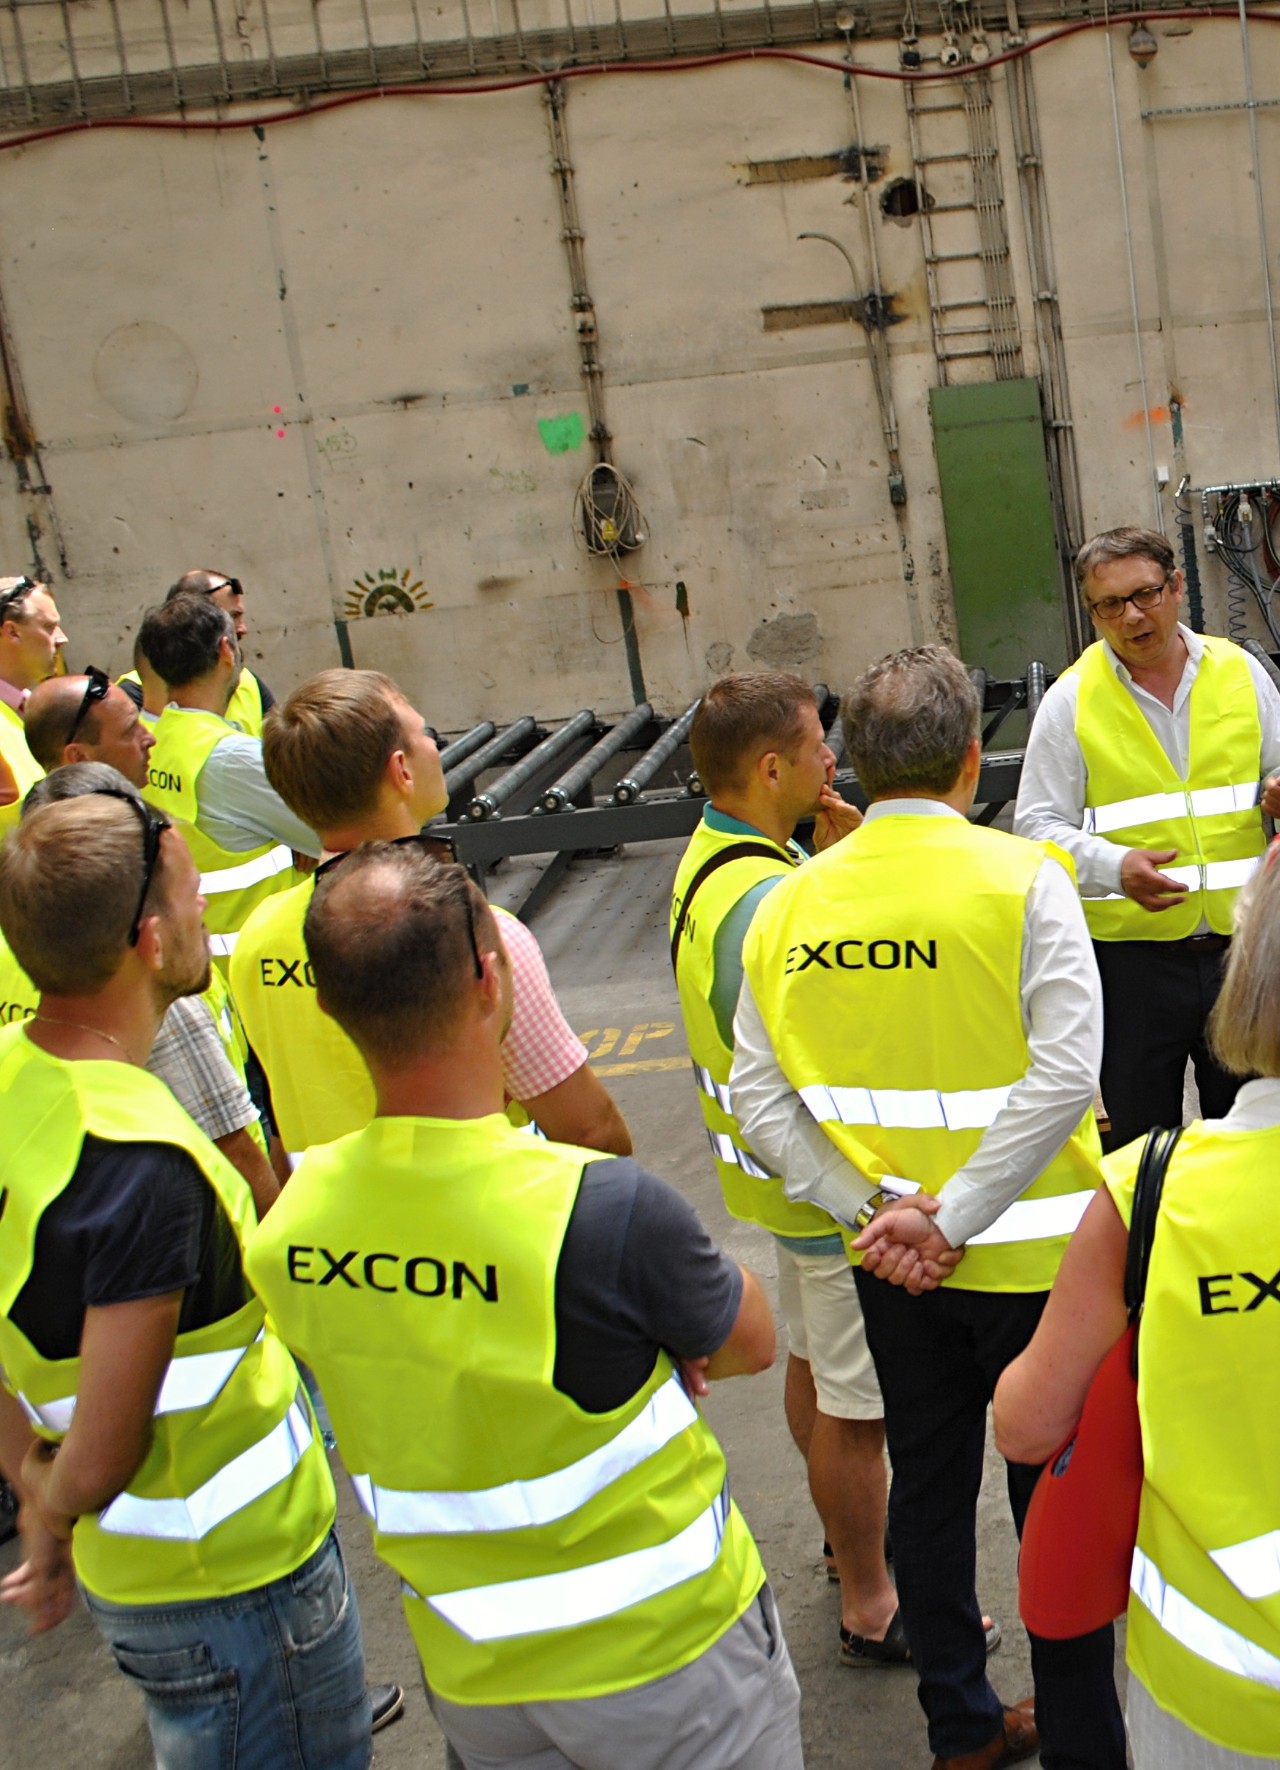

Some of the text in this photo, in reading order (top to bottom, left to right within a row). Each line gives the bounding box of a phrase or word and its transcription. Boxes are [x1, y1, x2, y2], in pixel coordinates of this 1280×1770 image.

[149, 768, 182, 793] CON
[785, 939, 938, 975] EXCON
[577, 1021, 676, 1060] OP
[287, 1244, 499, 1303] EXCON
